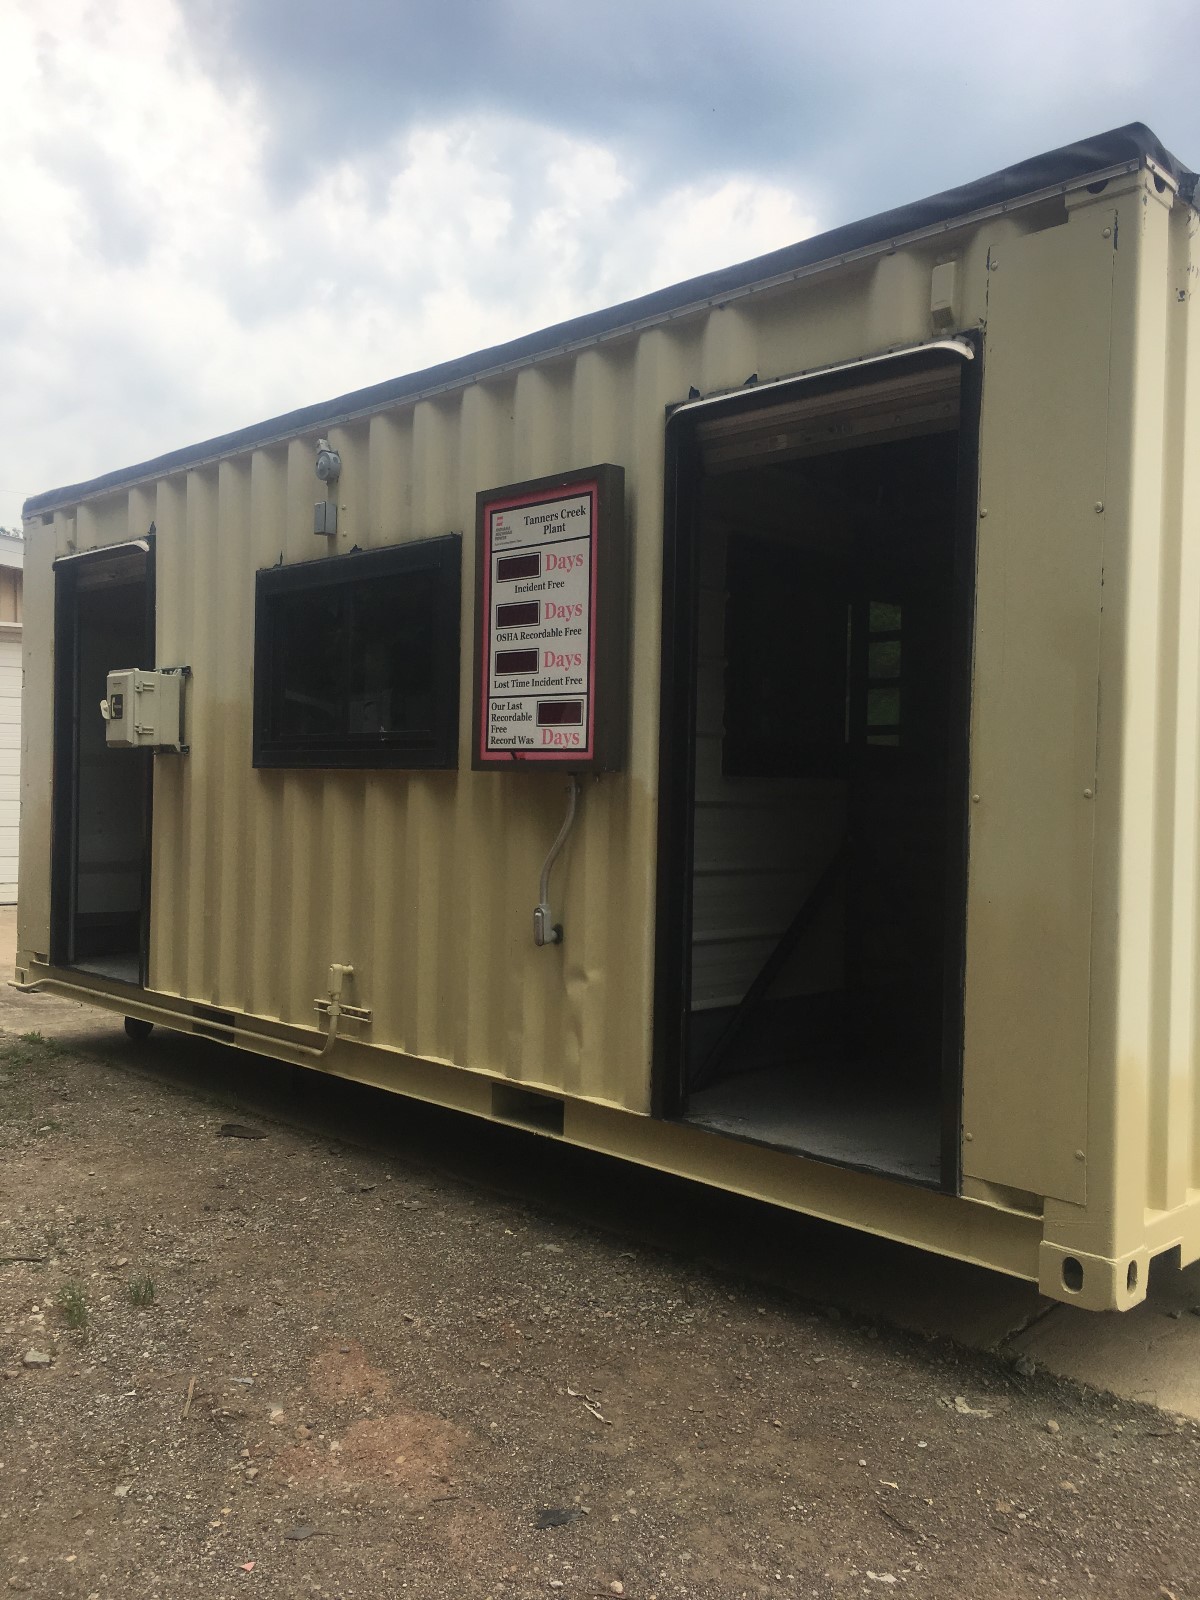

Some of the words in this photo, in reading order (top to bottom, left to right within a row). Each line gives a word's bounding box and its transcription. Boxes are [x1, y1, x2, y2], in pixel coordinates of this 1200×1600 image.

[524, 512, 559, 526] Tanners
[560, 506, 586, 519] Creek
[543, 523, 566, 534] Plant
[546, 553, 584, 573] Days
[514, 582, 546, 594] Incident
[548, 580, 565, 589] Free
[544, 602, 583, 622] Days
[496, 633, 518, 642] OSHA
[520, 630, 563, 640] Recordable
[564, 627, 582, 636] Free
[544, 651, 582, 671] Days
[494, 680, 509, 689] Lost
[511, 680, 530, 688] Time
[532, 677, 564, 687] Incident
[565, 676, 583, 686] Free
[492, 702, 505, 710] Our
[507, 702, 522, 710] Last
[491, 712, 532, 722] Recordable
[491, 725, 507, 733] Free
[490, 736, 516, 744] Record
[518, 736, 534, 744] Was
[542, 728, 580, 749] Days
